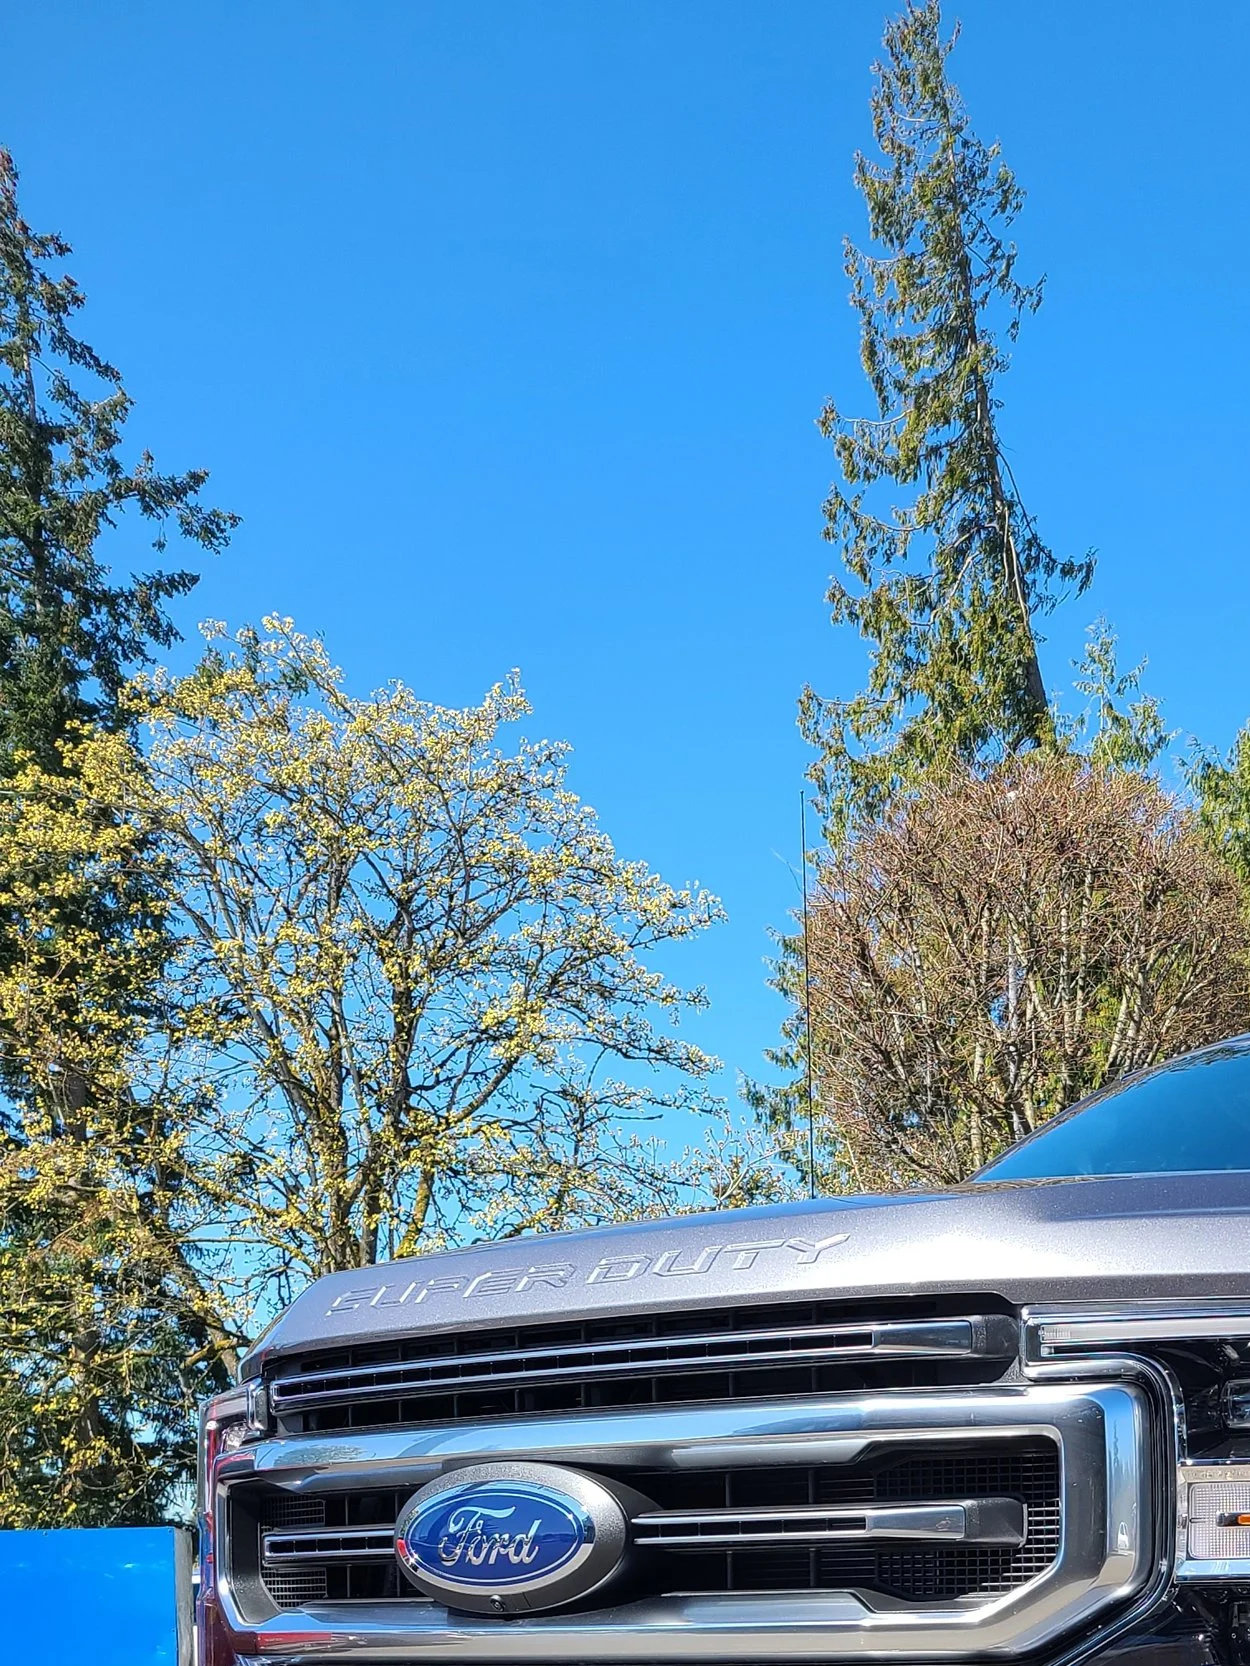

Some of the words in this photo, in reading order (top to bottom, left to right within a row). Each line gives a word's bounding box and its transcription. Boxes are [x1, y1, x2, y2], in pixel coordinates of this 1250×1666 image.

[325, 1263, 577, 1316] SUPER
[586, 1232, 851, 1286] DUTY
[438, 1505, 543, 1567] Ford
